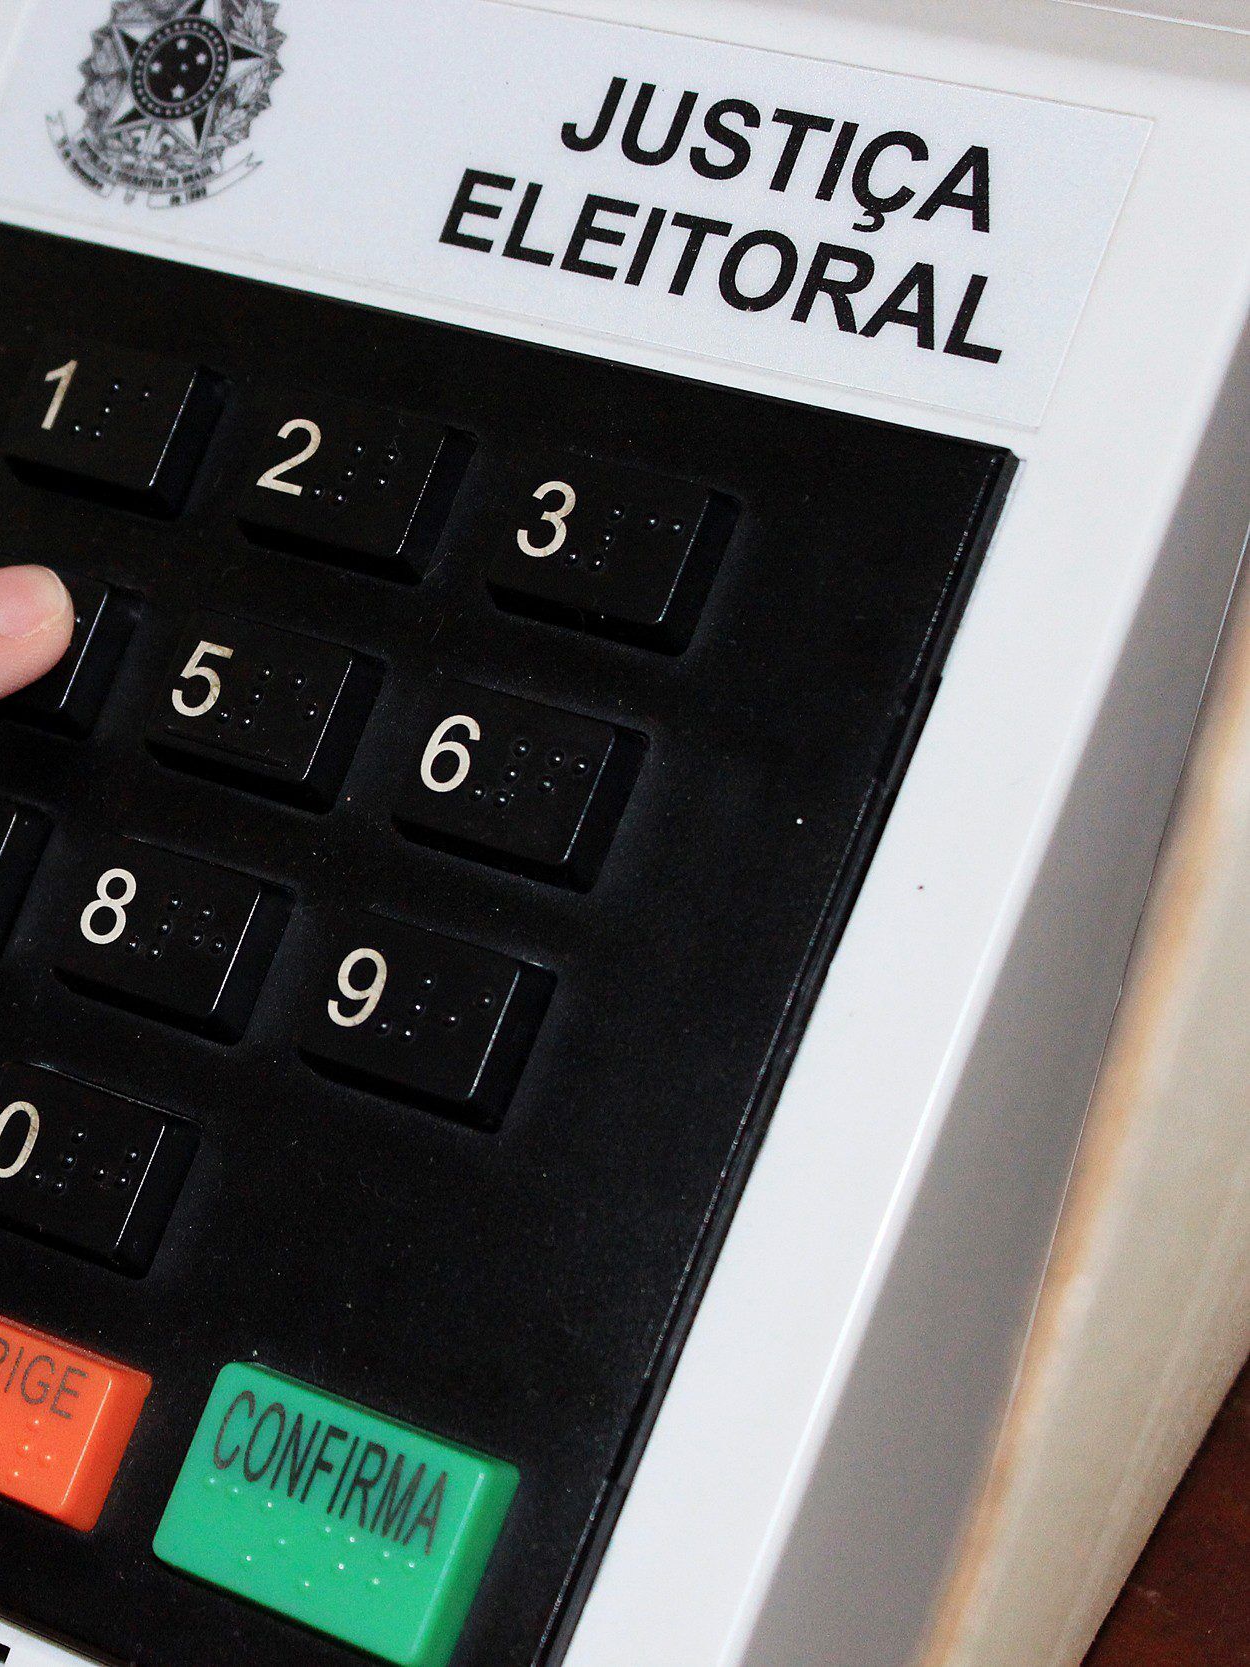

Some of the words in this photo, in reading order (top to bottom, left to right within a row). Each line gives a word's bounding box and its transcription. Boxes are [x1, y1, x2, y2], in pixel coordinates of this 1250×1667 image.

[560, 76, 991, 233] JUSTIÇA
[438, 168, 1003, 364] ELEITORAL
[37, 359, 78, 431] 1
[256, 418, 322, 497] 2
[516, 480, 577, 558] 3
[171, 640, 234, 718] 5
[420, 714, 481, 793] 6
[79, 867, 137, 945] 8
[327, 947, 388, 1028] 9
[212, 1390, 449, 1557] CONFIRMA
